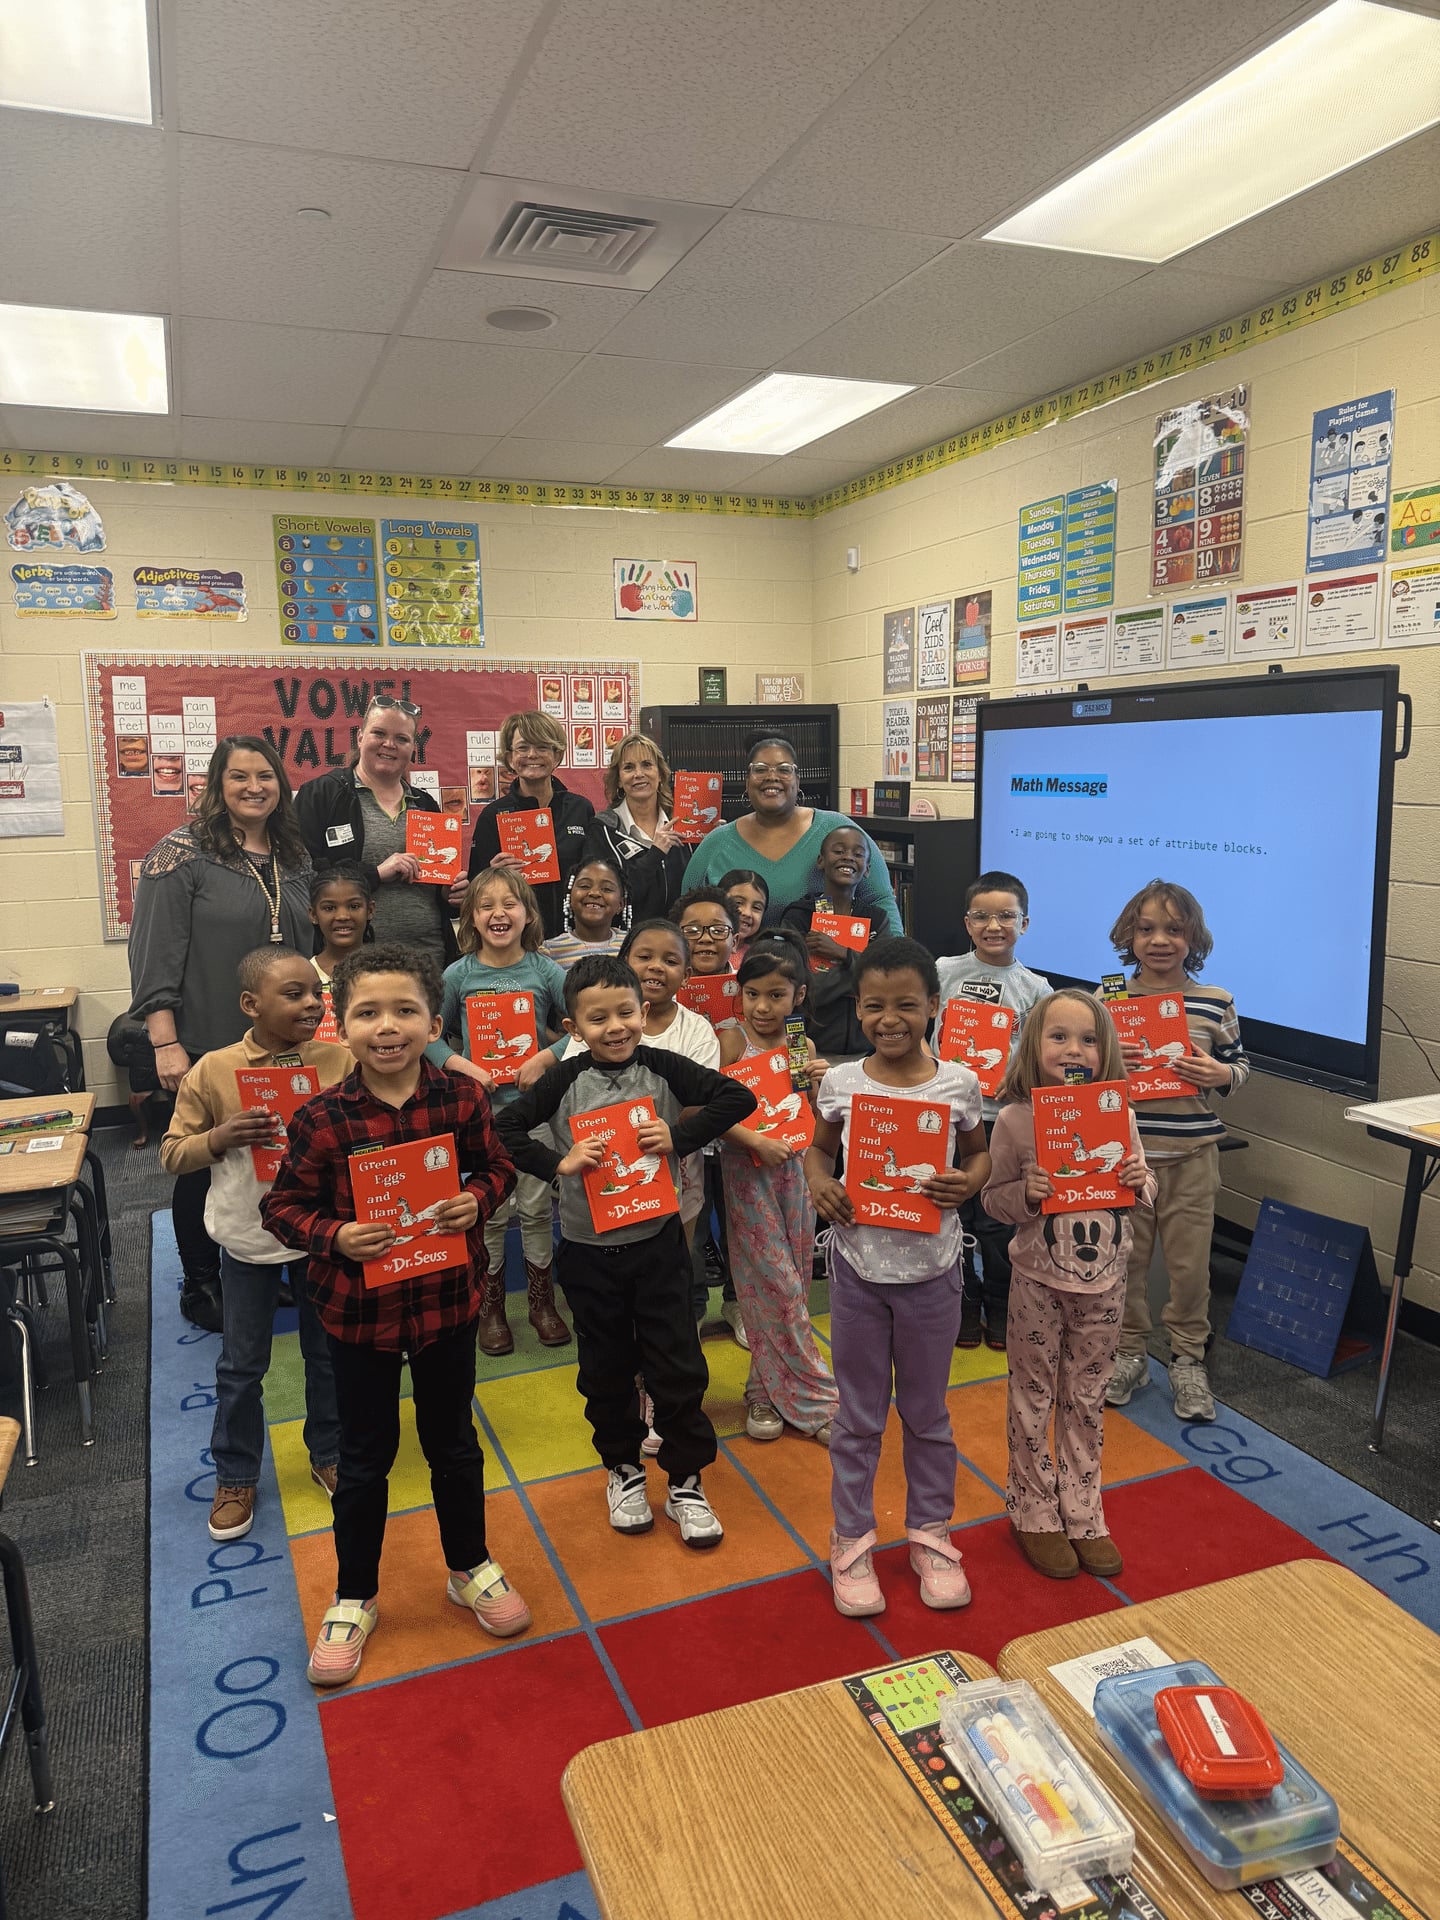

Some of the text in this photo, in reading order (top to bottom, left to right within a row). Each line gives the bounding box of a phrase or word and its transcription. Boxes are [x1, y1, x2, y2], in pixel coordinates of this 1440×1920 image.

[1078, 241, 1431, 402] 72 74 75 76 78 80 81 82 83 84 85 86 87 88
[1339, 406, 1356, 415] Rules
[1329, 408, 1378, 426] Playing Games
[4, 455, 672, 502] 6 8 10 12 13 14 15 16 18 22 24 25 32 38
[1200, 473, 1220, 484] SEVEN
[1201, 488, 1212, 506] 8
[1030, 505, 1054, 519] Sunday
[1157, 500, 1168, 518] 3
[1201, 506, 1216, 515] EIGHT
[1399, 501, 1432, 526] Aa
[278, 518, 371, 534] Short Vowels
[1157, 517, 1173, 525] THREE
[389, 521, 472, 537] Long Vowels
[1028, 521, 1054, 534] Monday
[1200, 520, 1212, 538] 9
[1026, 536, 1054, 549] Tuesday
[1157, 530, 1168, 548] 4
[1200, 538, 1216, 546] NINE
[1157, 547, 1172, 555] FOUR
[1022, 551, 1059, 566] Wednesday
[1198, 550, 1213, 570] 10
[15, 566, 53, 580] Verbs
[1025, 568, 1055, 580] Thursday
[1156, 560, 1167, 578] 5
[1198, 569, 1209, 577] TEN
[135, 568, 200, 584] Adjectives
[1155, 577, 1168, 585] FIVE
[1029, 584, 1050, 595] Friday
[1024, 599, 1055, 612] Saturday
[924, 634, 943, 648] KIDS
[921, 649, 946, 664] READ
[957, 648, 986, 659] READING
[922, 663, 945, 676] BOOKS
[959, 661, 984, 672] CORNER
[119, 681, 136, 690] me
[763, 694, 783, 702] THINGS
[117, 699, 142, 711] read
[186, 701, 208, 712] rain
[918, 704, 948, 715] SO MANY
[118, 719, 145, 731] feet
[157, 718, 176, 729] him
[188, 719, 211, 734] play
[886, 716, 910, 727] READER
[930, 716, 948, 726] BOOKS
[159, 738, 176, 752] rip
[187, 737, 214, 748] make
[470, 734, 491, 745] rule
[887, 737, 910, 746] LEADER
[262, 726, 432, 768] VALY
[930, 741, 947, 751] TIME
[470, 751, 491, 762] tune
[412, 771, 436, 784] joke
[1011, 778, 1107, 796] Math Message
[1036, 831, 1056, 841] going
[1062, 832, 1070, 840] to
[1075, 831, 1093, 842] show
[1099, 835, 1113, 845] you
[1128, 837, 1143, 846] set
[1149, 838, 1160, 847] of
[1165, 839, 1217, 852] attribute
[1224, 843, 1267, 855] blocks.
[979, 987, 994, 995] WAY
[482, 1011, 501, 1019] Eggs
[953, 1004, 976, 1014] Green
[1110, 1005, 1138, 1013] Green
[1122, 1015, 1145, 1026] Eggs
[1041, 1095, 1074, 1104] Green
[859, 1102, 893, 1115] Green
[1054, 1108, 1081, 1122] Eggs
[577, 1117, 607, 1129] Green
[870, 1118, 898, 1134] Eggs
[1046, 1126, 1067, 1135] and
[859, 1136, 880, 1146] and
[1048, 1141, 1072, 1150] Ham
[859, 1149, 884, 1161] Ham
[359, 1159, 397, 1172] Green
[375, 1172, 406, 1187] Eggs
[367, 1192, 390, 1204] and
[370, 1209, 397, 1219] Ham
[1181, 1424, 1282, 1484] Gg
[191, 1540, 283, 1609] Pp
[196, 1656, 287, 1759] Oo
